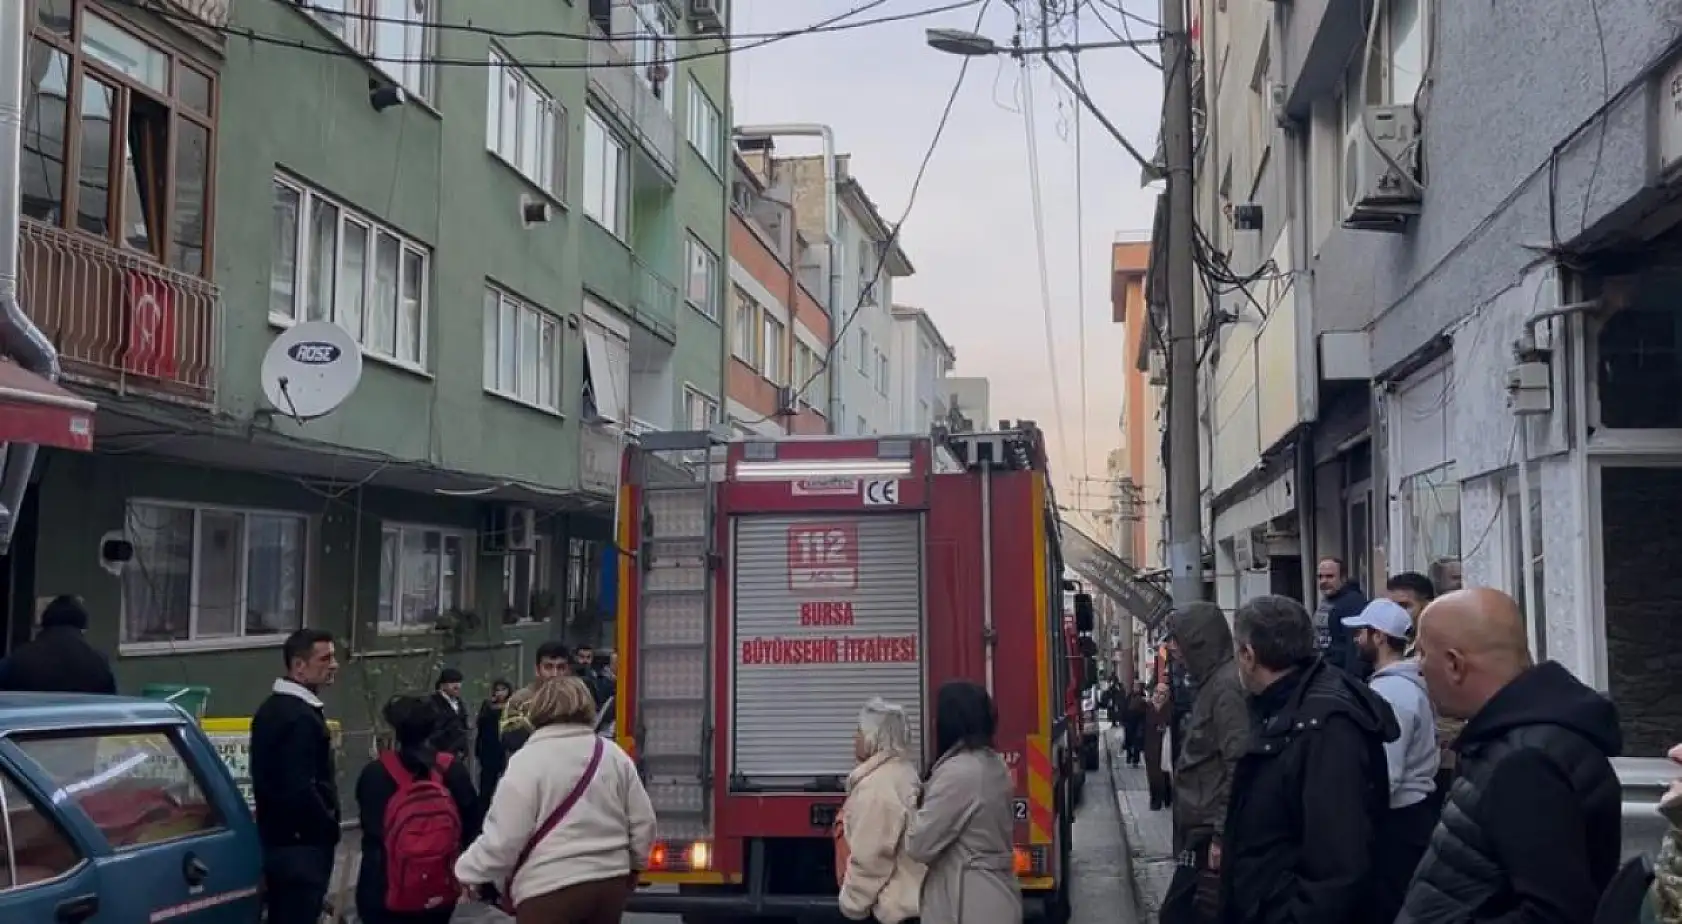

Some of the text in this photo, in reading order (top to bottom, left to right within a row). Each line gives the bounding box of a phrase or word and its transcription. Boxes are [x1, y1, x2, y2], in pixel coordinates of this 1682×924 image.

[295, 345, 335, 361] ROSE
[797, 530, 847, 564] 112
[801, 602, 854, 626] BURSA
[742, 633, 917, 664] BÜYÜKŞEHİR İTFAİYESİ
